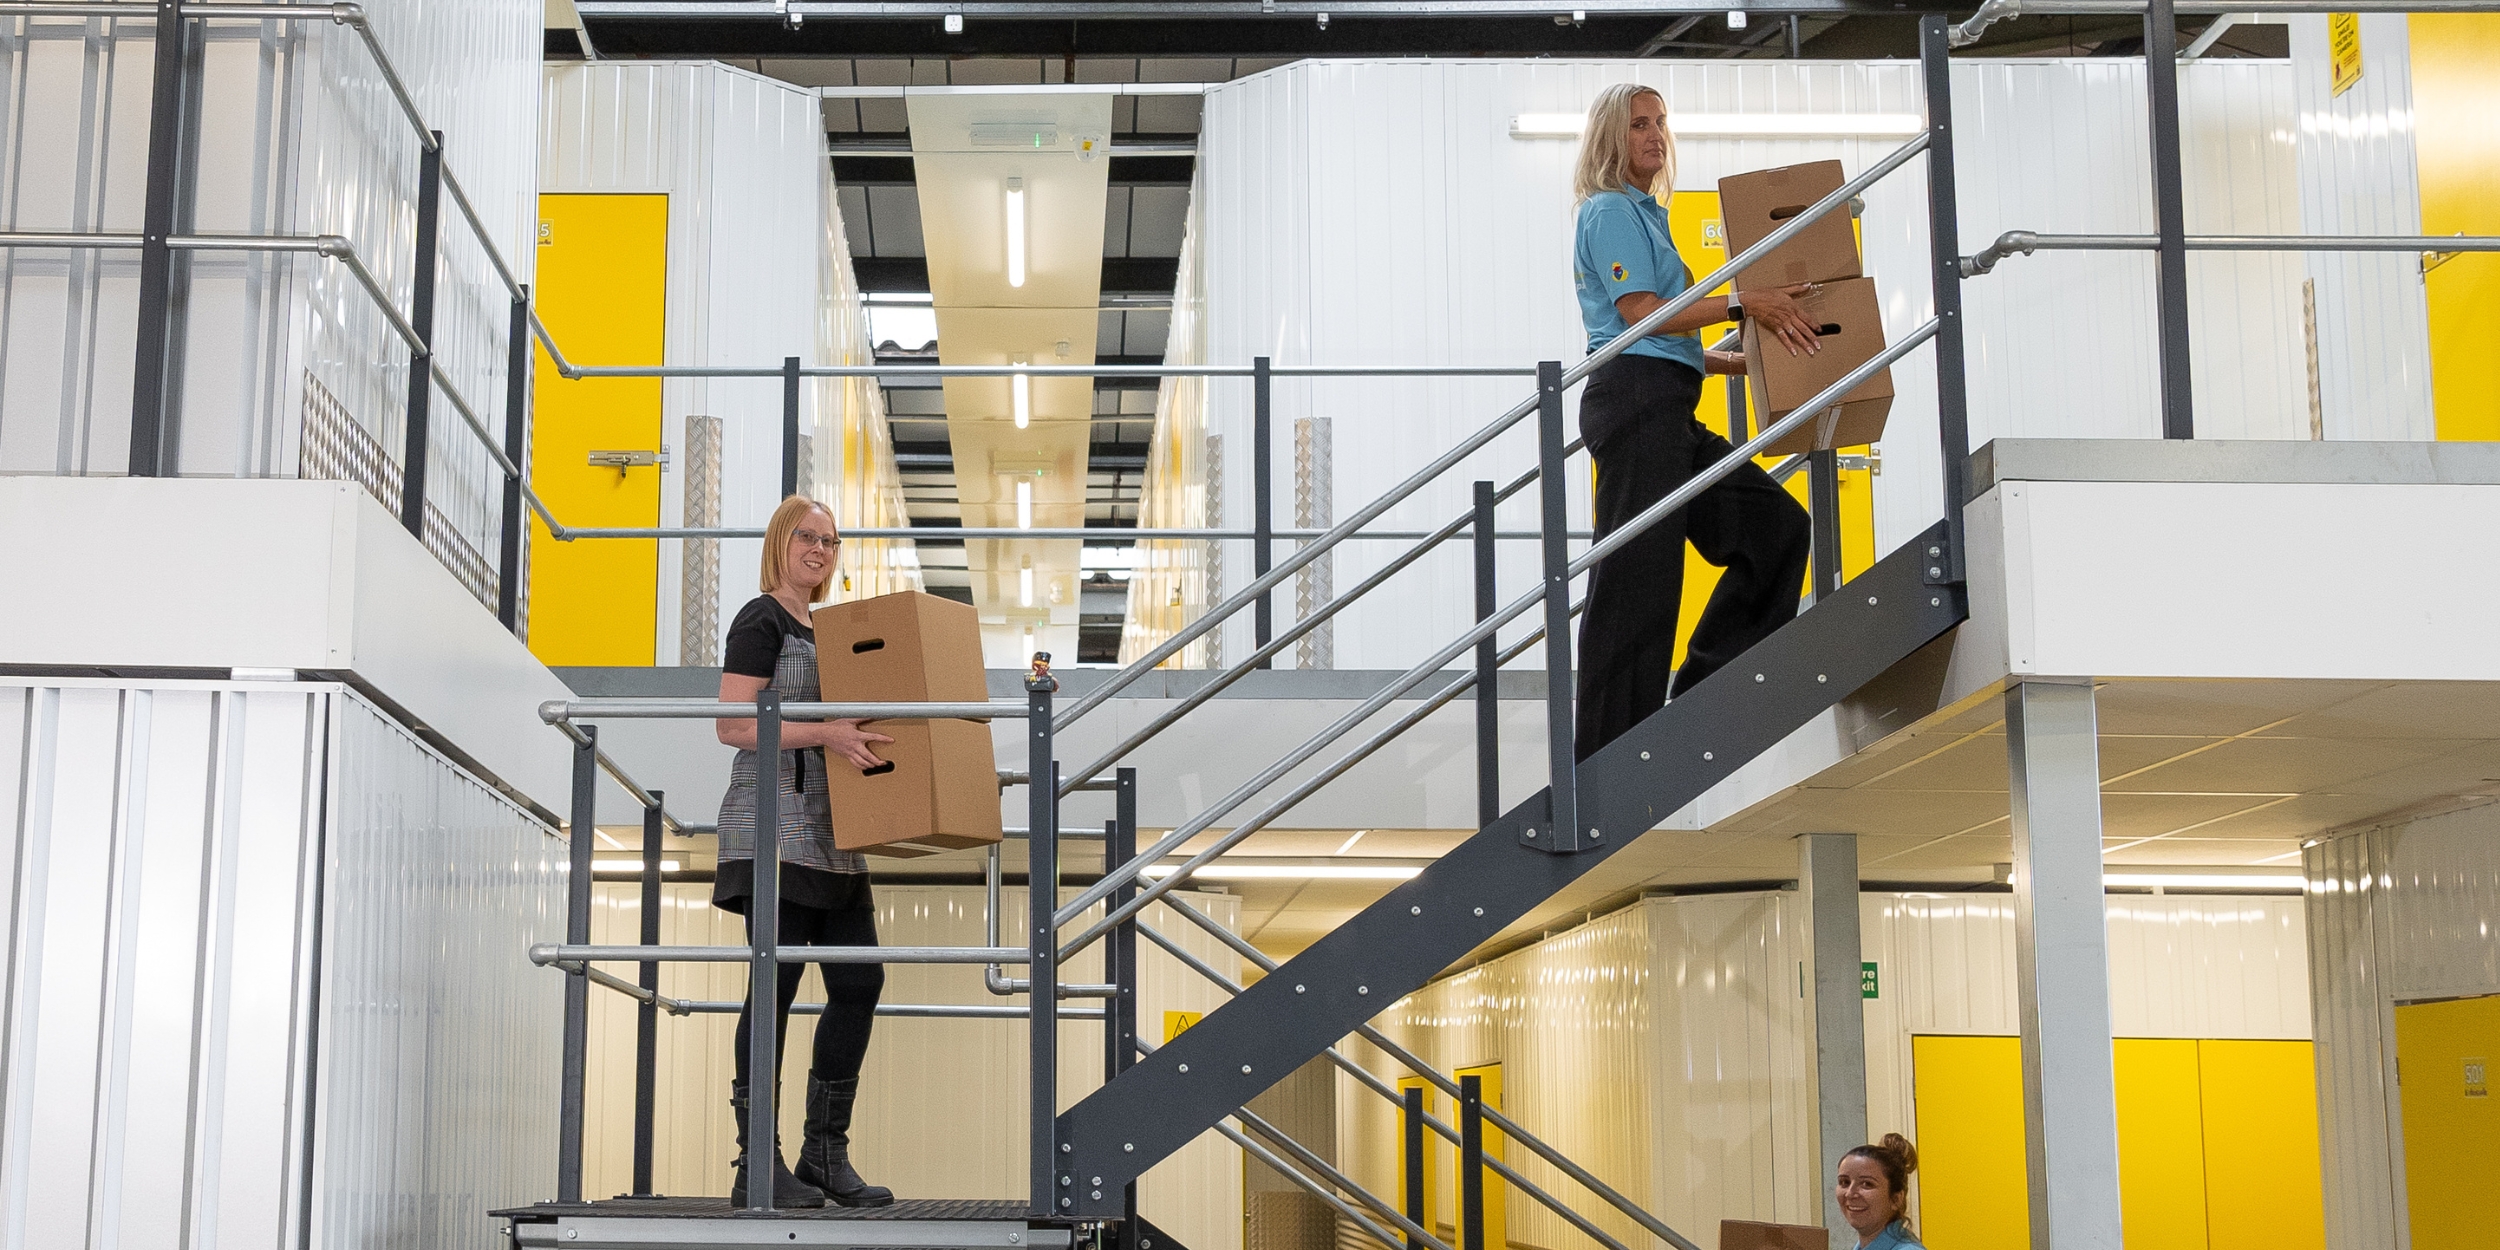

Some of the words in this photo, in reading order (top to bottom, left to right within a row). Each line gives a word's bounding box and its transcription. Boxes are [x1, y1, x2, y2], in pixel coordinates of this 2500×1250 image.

[538, 223, 550, 237] 5
[1862, 970, 1875, 979] re
[1862, 981, 1875, 991] xit
